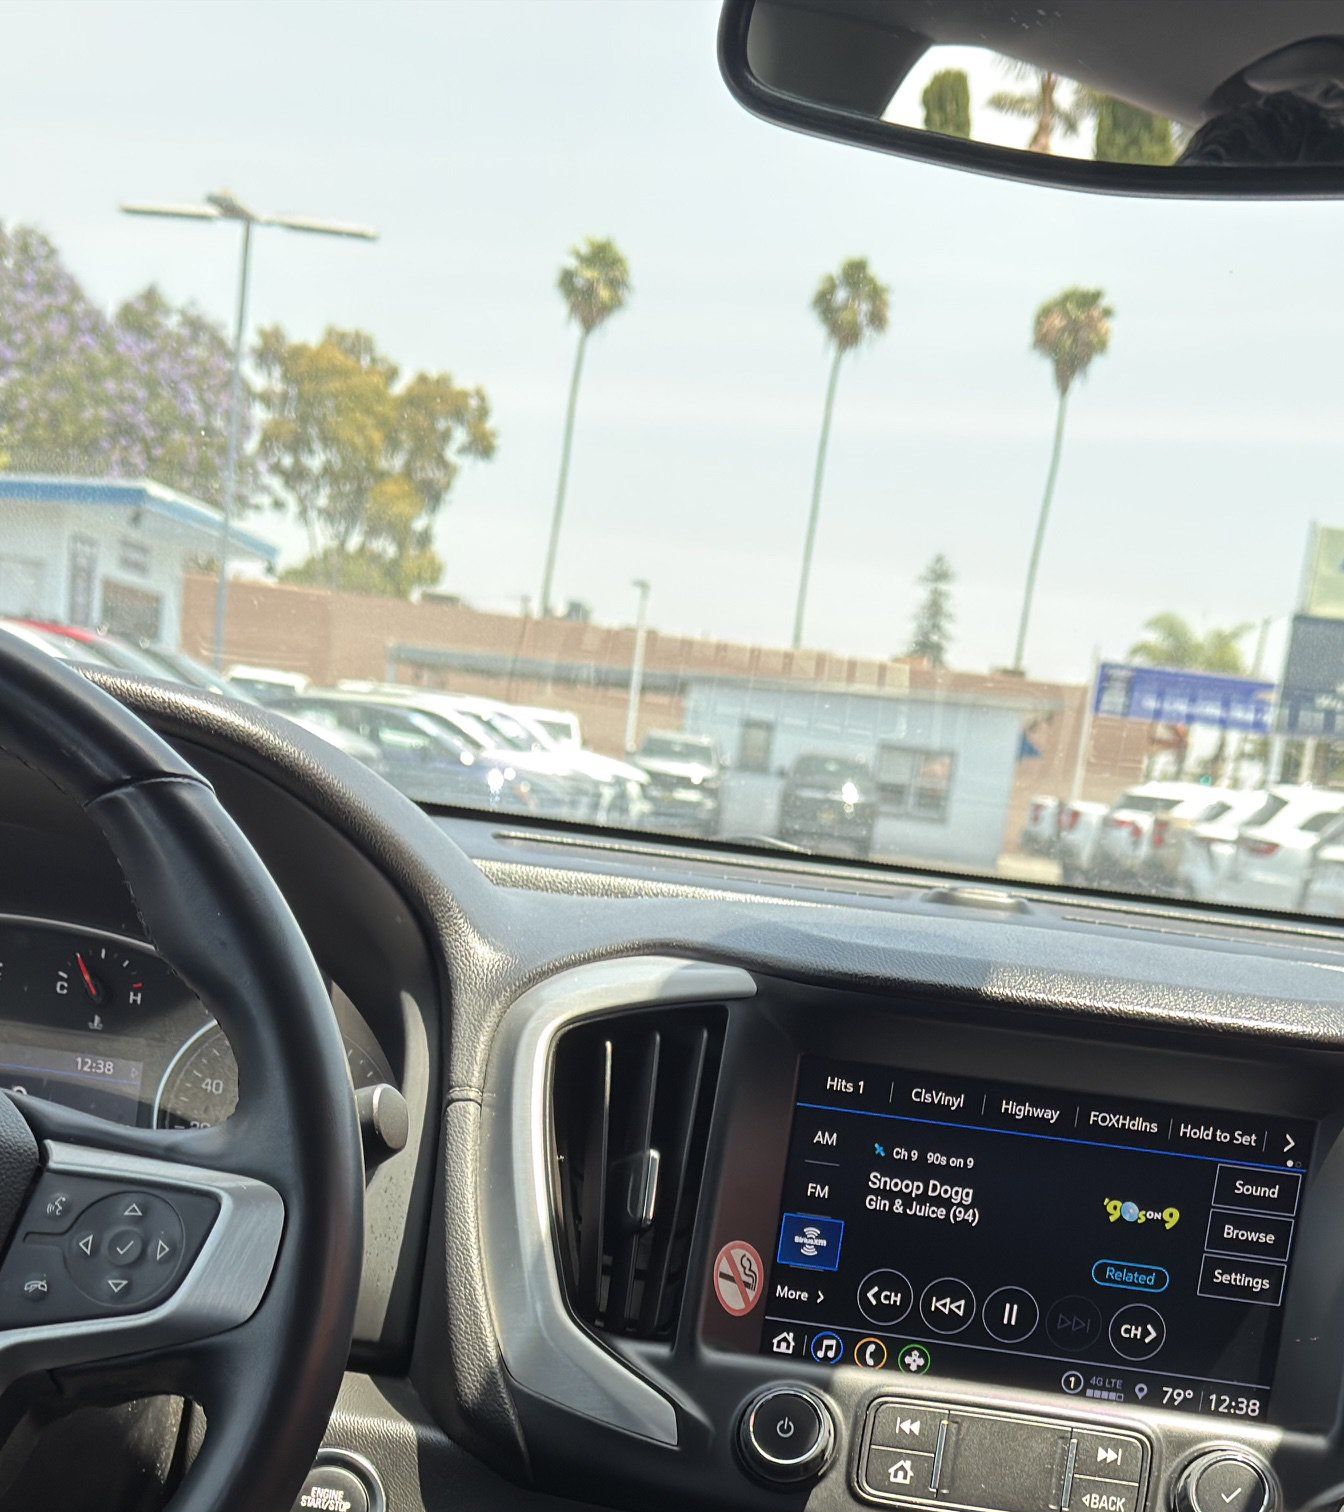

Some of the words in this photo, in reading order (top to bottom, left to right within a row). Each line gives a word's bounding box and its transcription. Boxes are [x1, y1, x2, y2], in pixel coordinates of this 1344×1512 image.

[56, 981, 68, 995] C
[129, 991, 142, 1005] H
[75, 1056, 114, 1076] 12:38
[201, 1077, 224, 1095] 40
[826, 1076, 854, 1093] Hits
[858, 1080, 865, 1094] 1
[911, 1088, 964, 1110] ClsVinyl
[1001, 1099, 1060, 1123] Highway
[813, 1130, 838, 1147] AM
[1179, 1123, 1213, 1141] Hold
[1216, 1128, 1230, 1143] to
[1233, 1130, 1257, 1147] Set
[893, 1147, 908, 1161] Ch
[911, 1149, 919, 1162] 9
[927, 1152, 947, 1167] 90s
[949, 1157, 964, 1168] on
[967, 1157, 974, 1169] 9
[807, 1183, 829, 1199] FM
[868, 1171, 924, 1197] Snoop
[928, 1179, 974, 1205] Dogg
[1234, 1180, 1279, 1199] Sound
[865, 1195, 889, 1212] Gin
[893, 1198, 904, 1214] &
[906, 1200, 947, 1220] Juice
[950, 1206, 979, 1227] (94)
[1147, 1210, 1162, 1220] ON
[1162, 1207, 1180, 1230] 9
[1223, 1224, 1275, 1245] Browse
[1105, 1265, 1156, 1287] Related
[1213, 1269, 1270, 1292] Settings
[776, 1285, 808, 1302] More
[881, 1291, 902, 1306] CH
[1120, 1323, 1142, 1339] CH
[1089, 1376, 1103, 1388] 4G
[1106, 1378, 1123, 1390] LTE
[1162, 1386, 1194, 1406] 79°
[1209, 1393, 1260, 1417] 12:38
[300, 1495, 351, 1512] START/STOP
[311, 1486, 345, 1502] ENGINE
